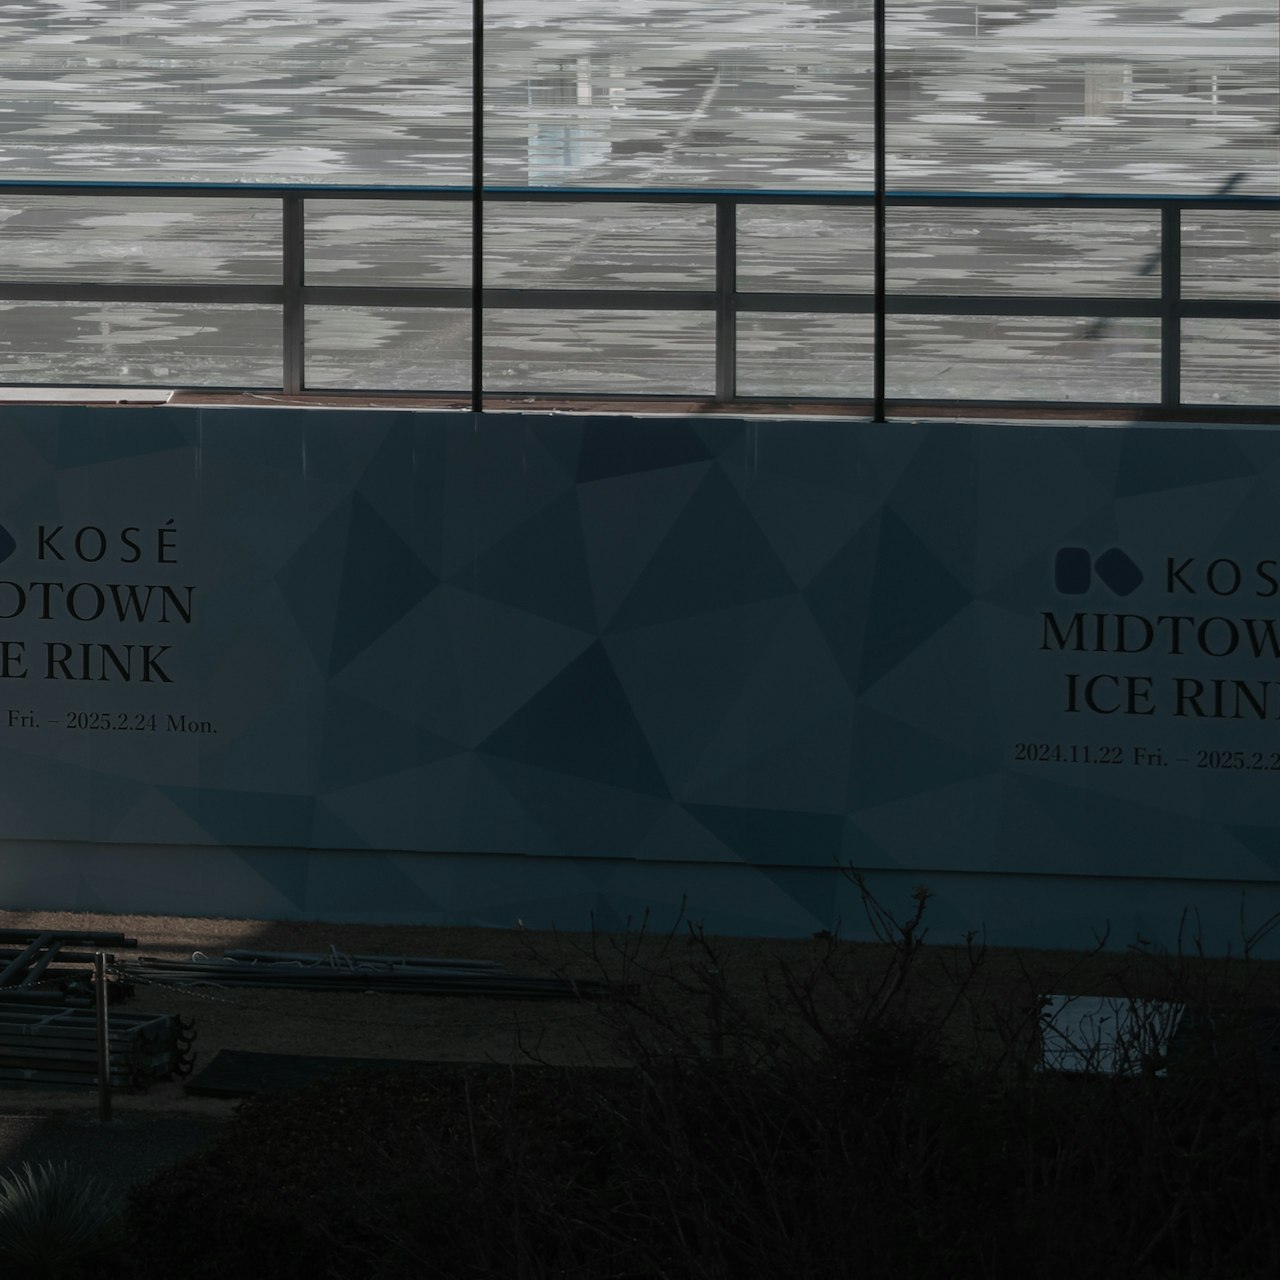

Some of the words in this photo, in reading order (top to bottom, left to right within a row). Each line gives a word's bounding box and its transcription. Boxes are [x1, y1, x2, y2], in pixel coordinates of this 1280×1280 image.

[39, 519, 176, 563] KOSÉ
[1168, 558, 1280, 597] KOS
[1040, 612, 1280, 658] MIDTOW
[43, 643, 173, 682] RINK
[1066, 675, 1155, 714] ICE
[1173, 678, 1280, 719] RIN
[9, 710, 39, 727] Fri.
[67, 712, 155, 731] 2025.2.24
[168, 715, 216, 733] Mon.
[1016, 743, 1122, 764] 2024.11.22
[1134, 747, 1167, 766] Fri.
